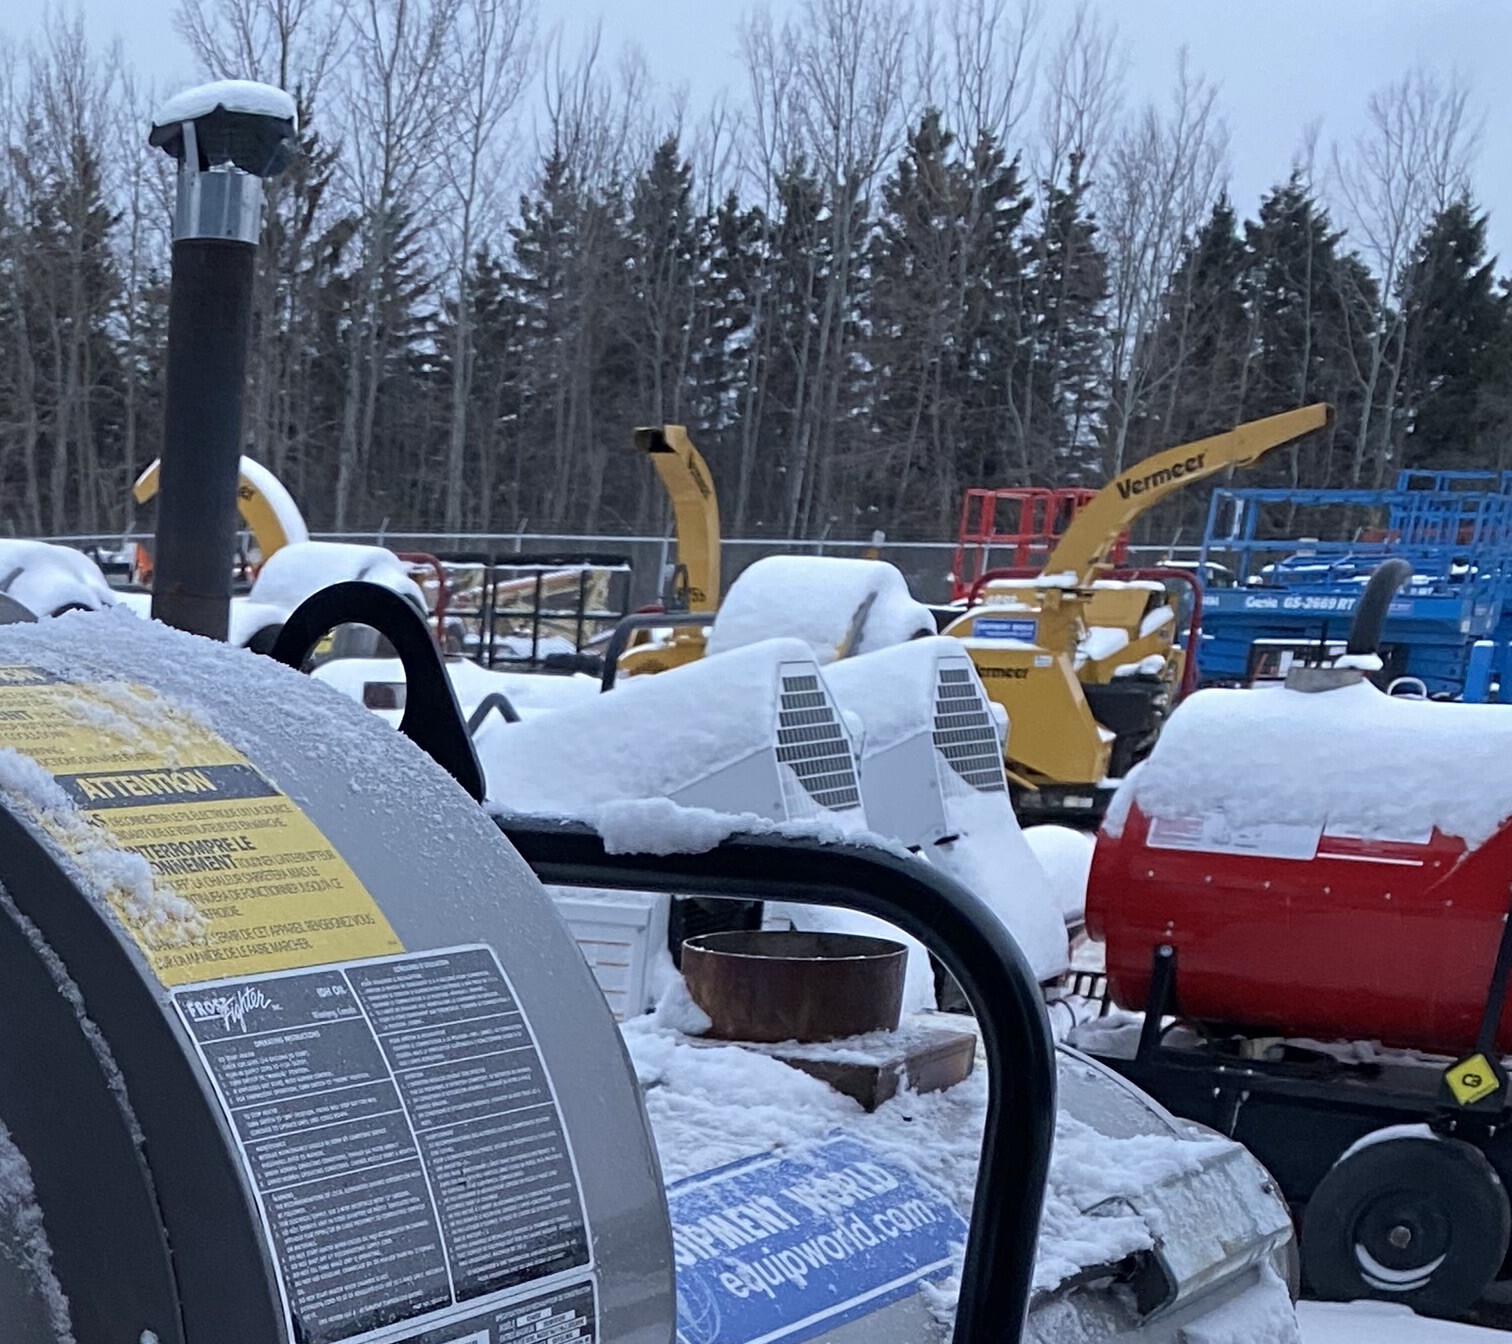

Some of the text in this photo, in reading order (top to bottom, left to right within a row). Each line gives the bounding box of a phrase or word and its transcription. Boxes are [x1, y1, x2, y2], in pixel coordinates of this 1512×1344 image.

[1117, 453, 1207, 500] Vermeer
[1337, 597, 1356, 611] RT
[76, 769, 217, 801] ATTENTION
[230, 836, 256, 850] LE
[149, 853, 236, 876] ONNEMENT
[186, 990, 280, 1030] FROST Fighter
[673, 1195, 801, 1266] UIPMENT
[718, 1198, 937, 1300] equipworld.com
